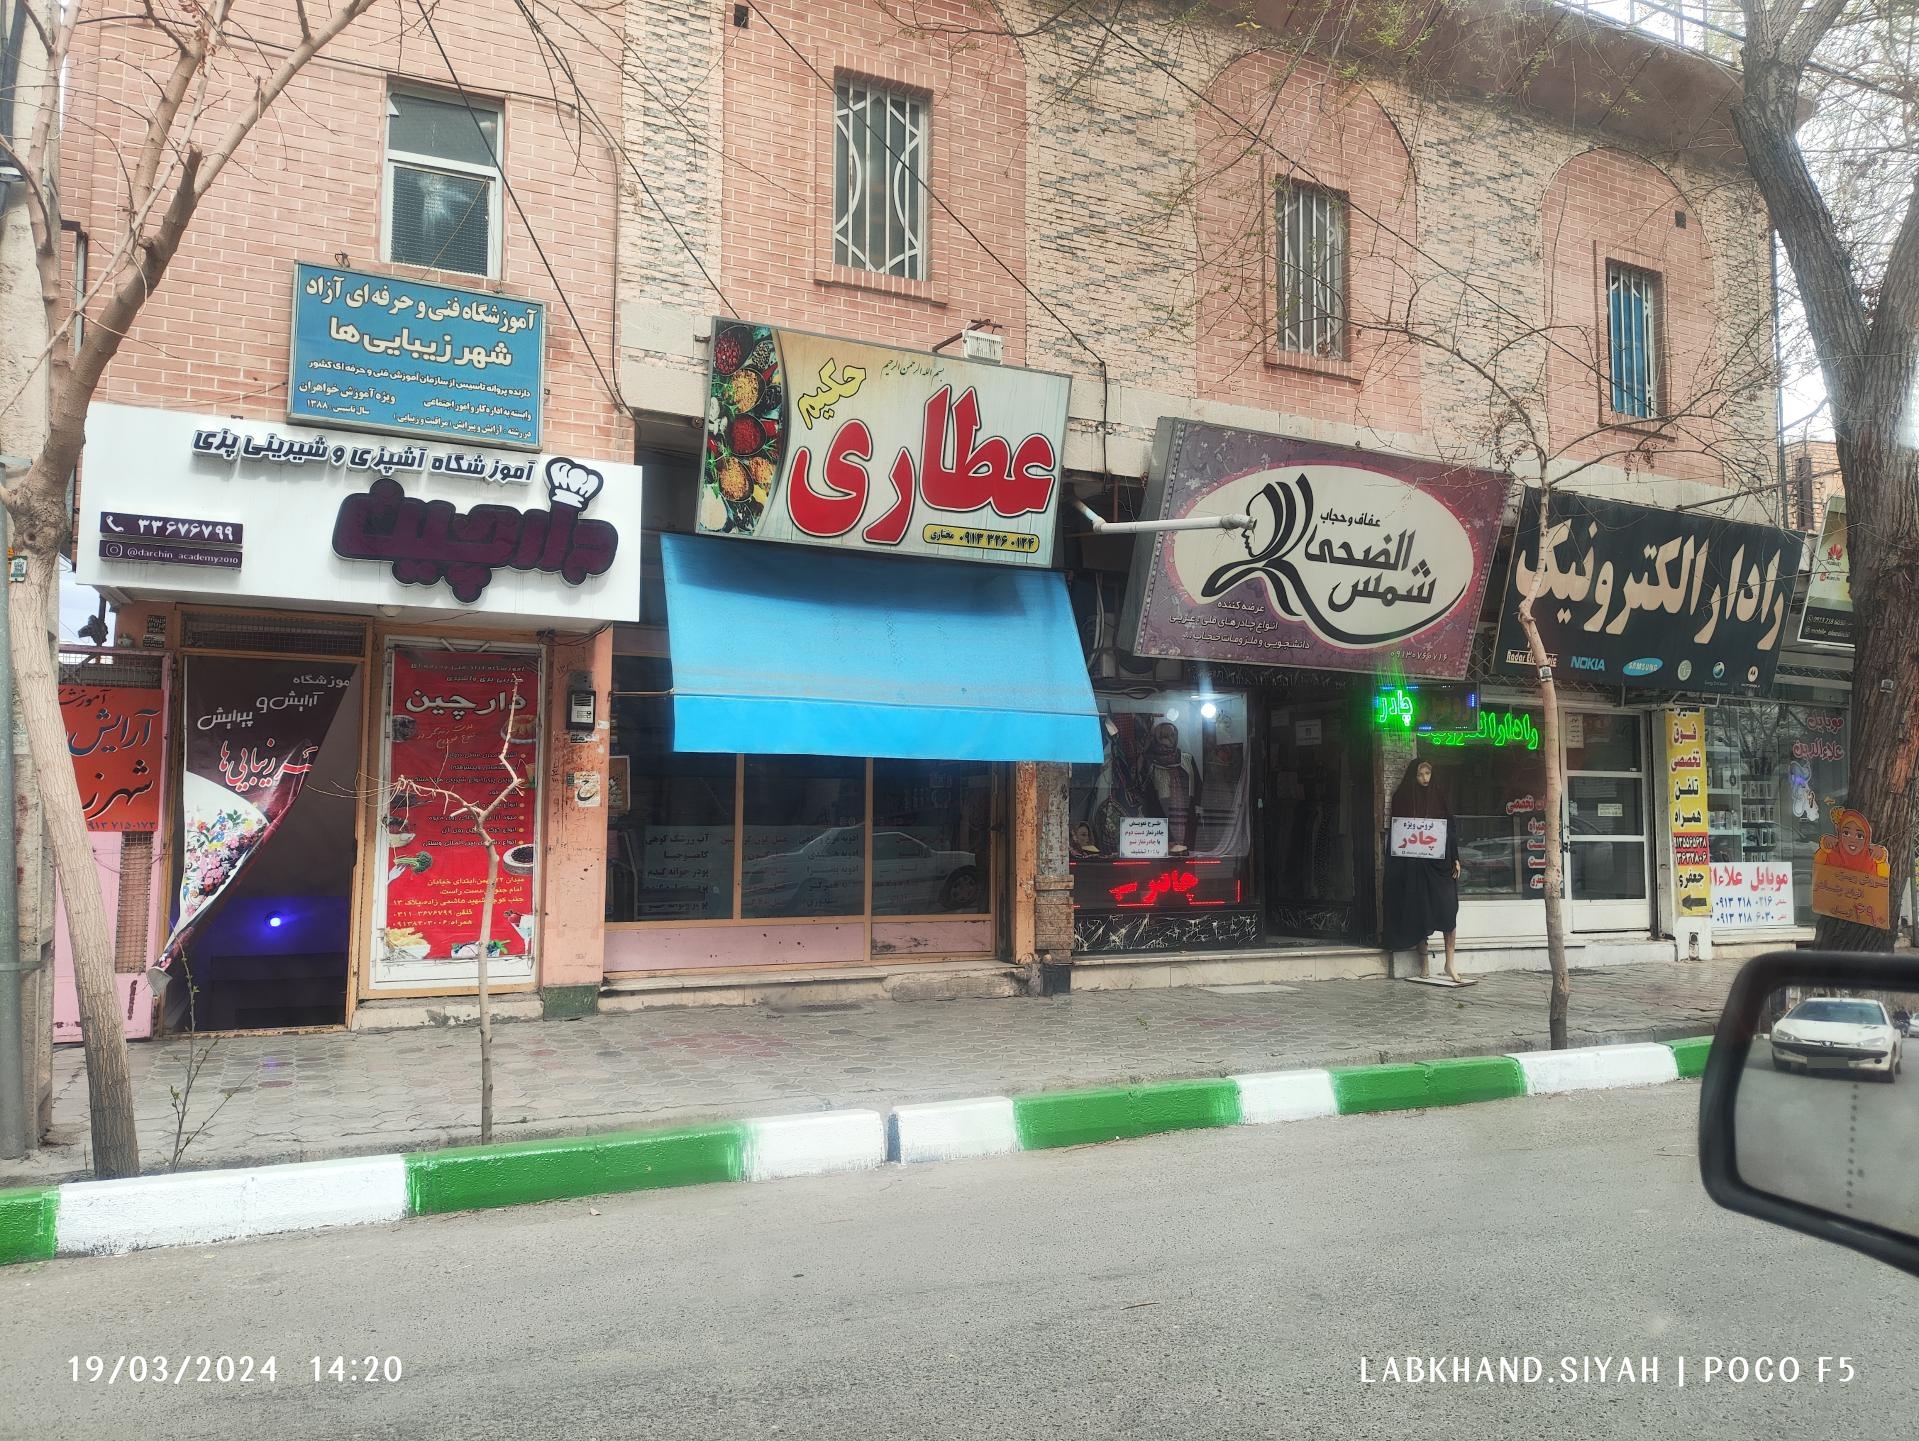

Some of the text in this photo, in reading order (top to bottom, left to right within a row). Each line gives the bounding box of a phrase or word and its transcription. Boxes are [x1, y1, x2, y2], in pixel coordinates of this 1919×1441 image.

[306, 275, 538, 333] آموزشگاه فنی و حرفه ای آزاد
[309, 359, 333, 369] کشور
[455, 341, 513, 369] شهر
[366, 368, 372, 376] و
[419, 374, 449, 386] سازمان
[880, 360, 945, 387] بسم الله الرحمن الرحیم
[299, 380, 397, 404] ویژه آموزش خواهران
[797, 357, 867, 430] حکیم
[423, 398, 455, 409] اجتماعی
[193, 429, 538, 483] آموزشگاه آشپزی و شیرینی پزی
[787, 384, 1055, 545] عطاری
[1320, 508, 1381, 528] عفاف و حجاب
[138, 518, 234, 541] ۳۳۶۷۶۷۹۹
[1305, 523, 1416, 572] الضحی
[1327, 558, 1437, 613] شمس
[1516, 518, 1784, 651] رادار الکترونیک
[1217, 600, 1265, 614] عرضه کننده
[1217, 618, 1256, 632] چادرهای
[1255, 621, 1279, 634] انواع
[1221, 634, 1258, 647] ملزومات
[1257, 639, 1263, 648] و
[1264, 640, 1311, 650] دانشجویی
[1506, 650, 1526, 663] Radar
[1570, 656, 1605, 671] NOKIA
[1628, 661, 1658, 672] SAMSUNG
[293, 674, 350, 689] موزشگاه
[58, 688, 111, 708] آموزش
[256, 690, 325, 713] آرایش و
[405, 688, 527, 720] دارچین
[1378, 689, 1413, 727] چادر
[197, 706, 254, 730] پیرایش
[1807, 711, 1845, 734] موبایل
[68, 708, 161, 756] آرایش
[1673, 722, 1697, 744] فوق
[1671, 750, 1702, 772] تخصصی
[87, 760, 155, 821] شهر
[1674, 778, 1699, 801] تلفن
[1506, 794, 1534, 815] تخصصی
[1403, 821, 1434, 831] فروش ویژه
[1674, 808, 1702, 828] همراه
[1397, 830, 1438, 851] چادر
[1679, 868, 1704, 889] جعفری
[1750, 866, 1789, 892] موبایل
[1716, 896, 1734, 908] ۰۹۱۳
[1716, 912, 1735, 924] ۰۹۱۳
